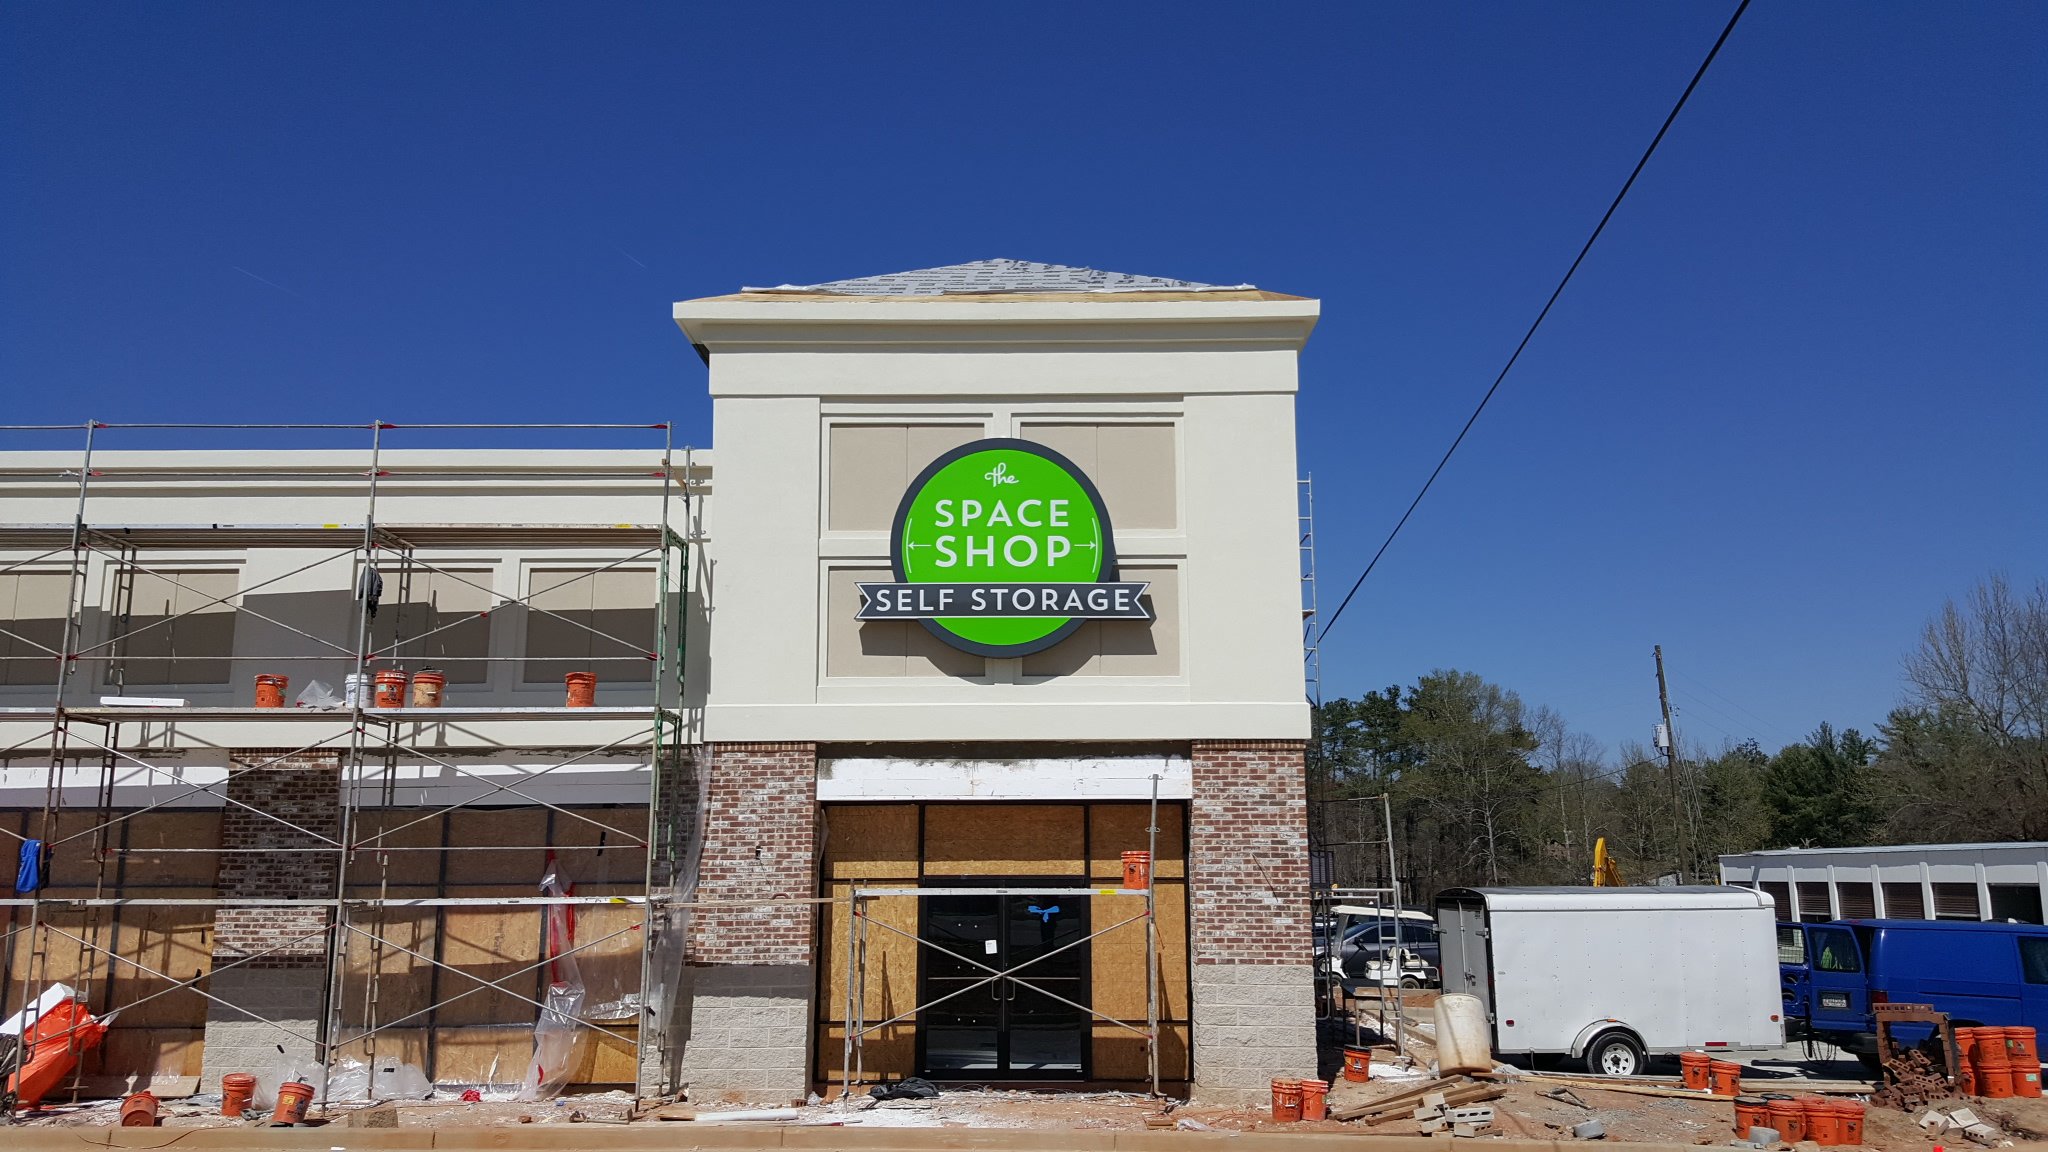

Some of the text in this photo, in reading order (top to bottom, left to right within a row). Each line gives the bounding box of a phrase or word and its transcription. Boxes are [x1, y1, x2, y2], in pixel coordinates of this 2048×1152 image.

[984, 462, 1019, 487] the
[935, 499, 1069, 527] SPACE
[935, 535, 1071, 567] SHOP
[876, 588, 1130, 611] SELF STORAGE
